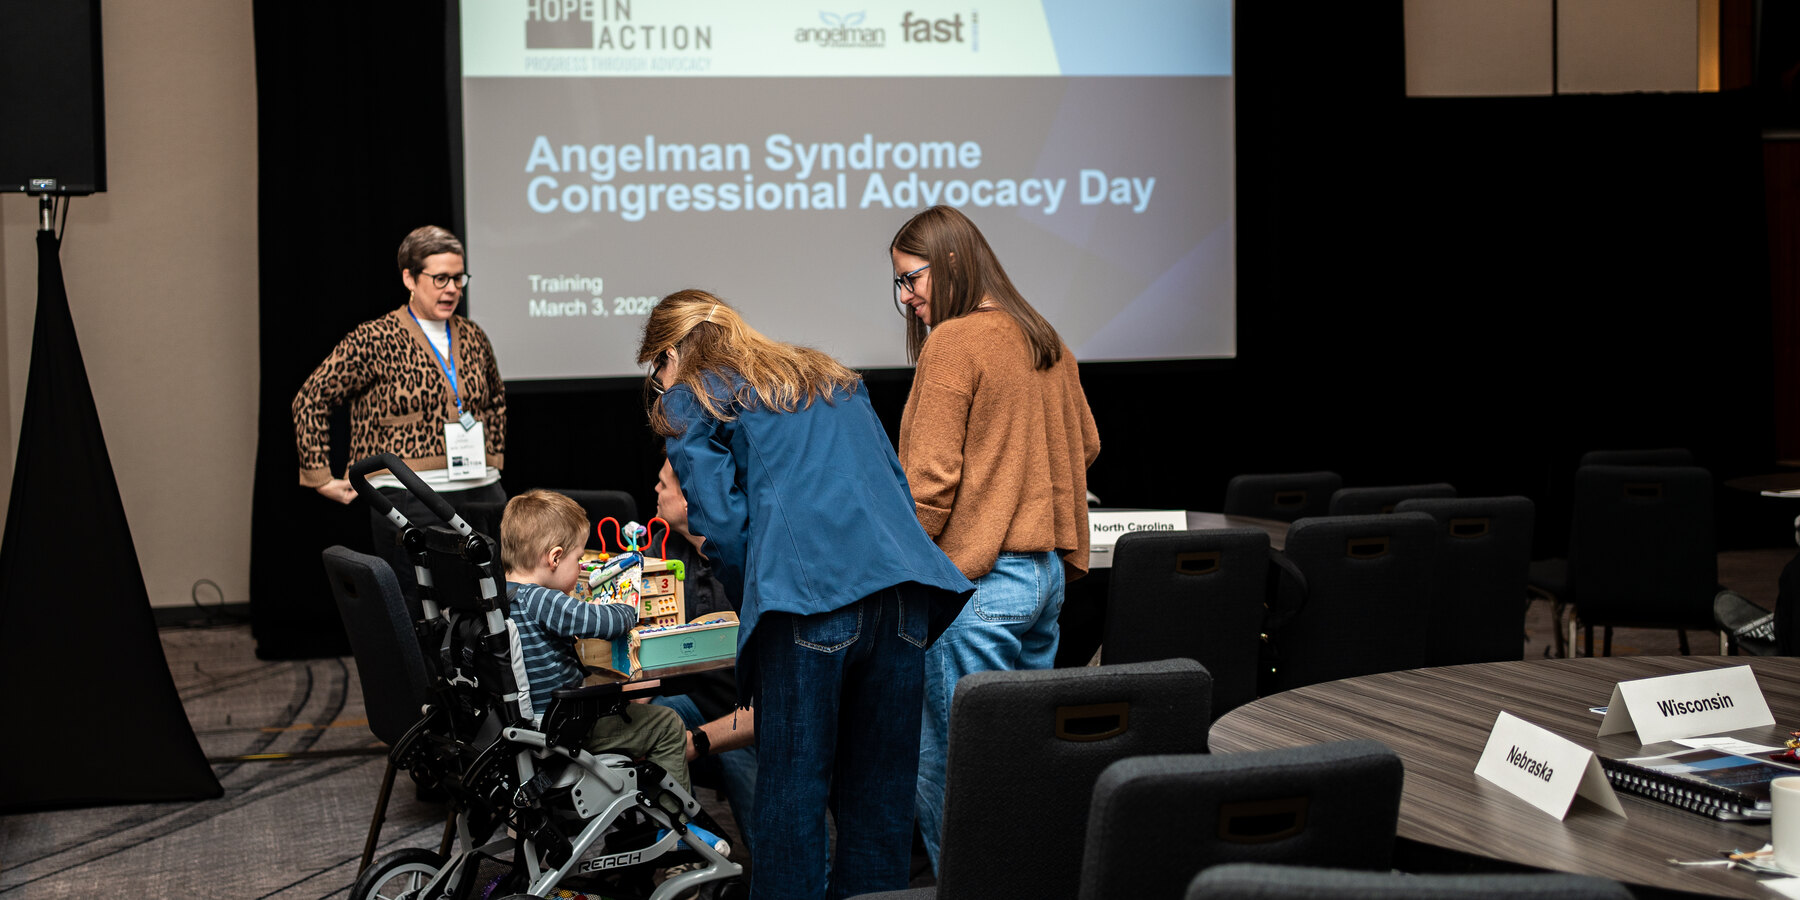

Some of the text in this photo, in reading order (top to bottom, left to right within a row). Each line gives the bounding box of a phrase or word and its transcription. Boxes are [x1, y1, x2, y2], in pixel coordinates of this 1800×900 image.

[526, 0, 631, 21] HOPE IN
[598, 25, 712, 50] ACTION
[795, 24, 886, 47] angelman
[901, 11, 964, 43] fast
[525, 133, 982, 182] Angelman Syndrome
[527, 169, 1156, 221] Congressional Advocacy Day
[528, 274, 603, 296] Training
[529, 299, 587, 317] March
[591, 297, 609, 318] 3,
[1093, 522, 1174, 532] North Carolina
[642, 578, 651, 589] 2
[661, 578, 669, 589] 3
[644, 600, 652, 611] 5
[1657, 693, 1734, 717] Wisconsin
[1506, 745, 1554, 782] Nebraska
[578, 853, 641, 873] REACH
